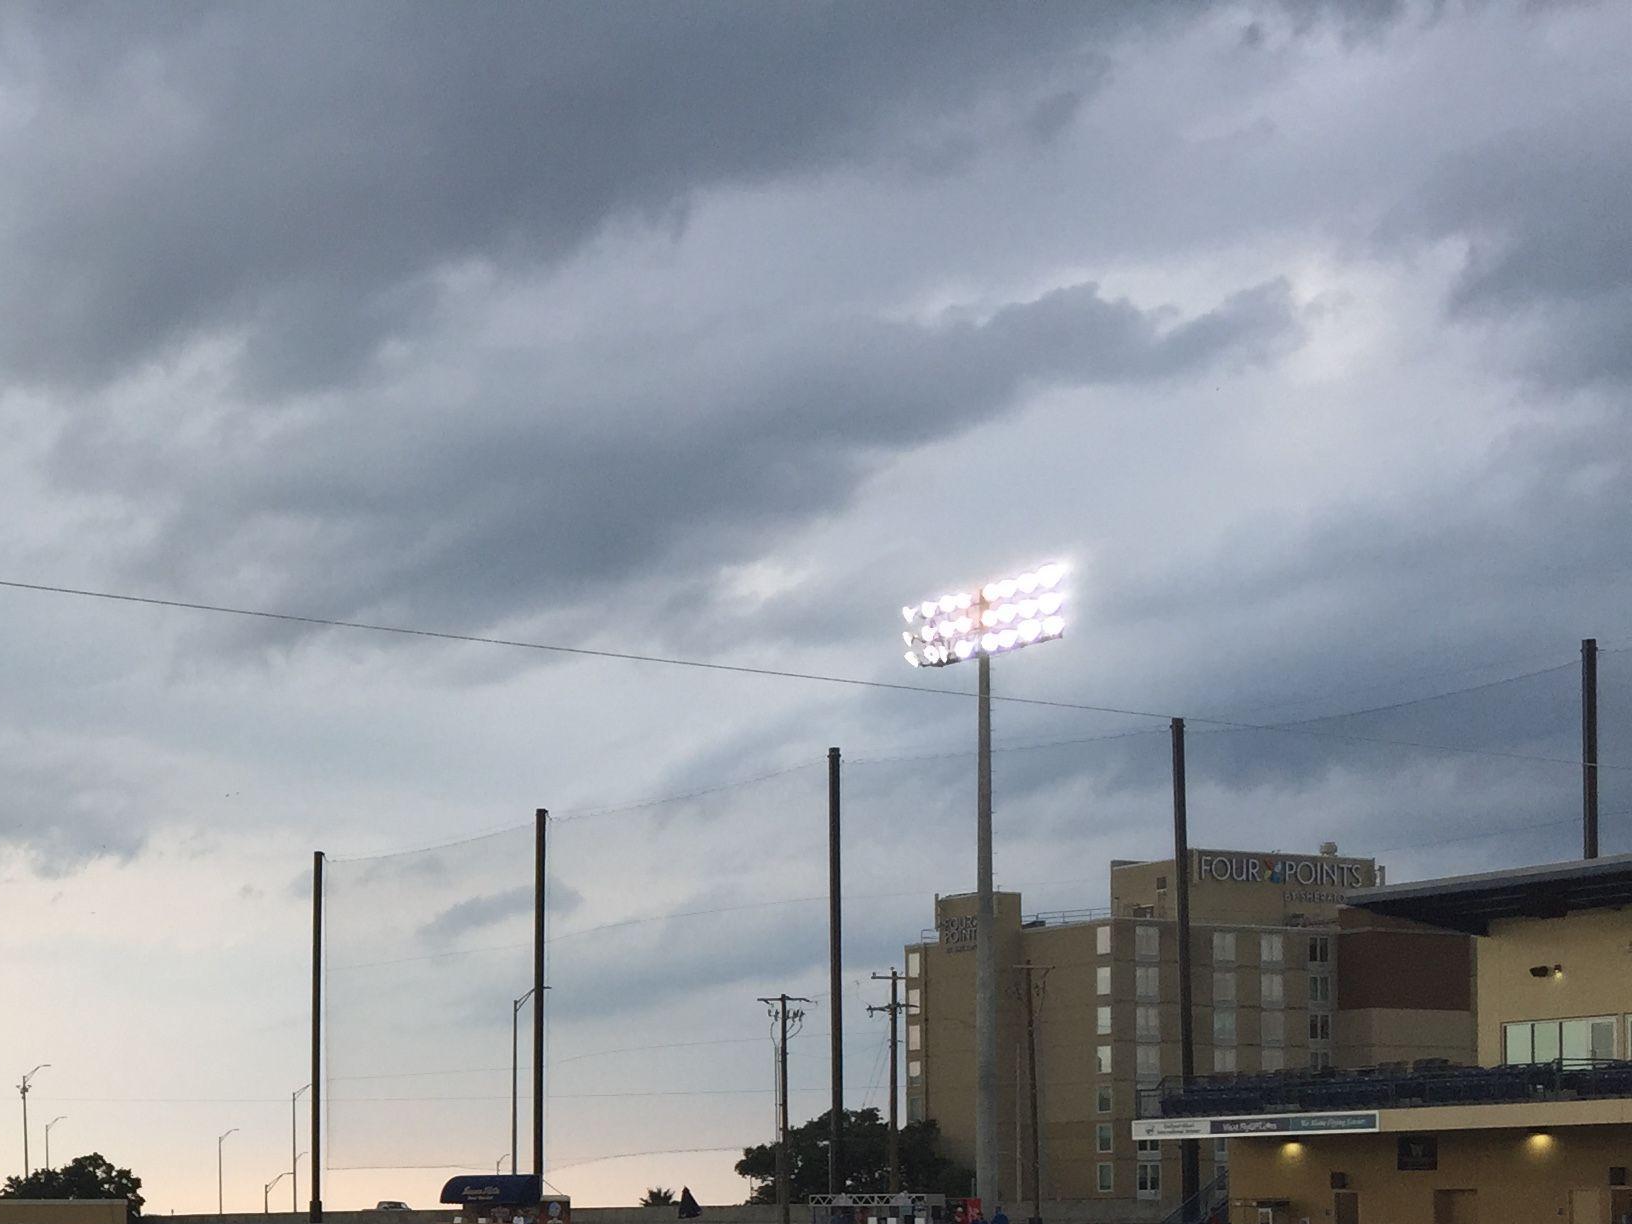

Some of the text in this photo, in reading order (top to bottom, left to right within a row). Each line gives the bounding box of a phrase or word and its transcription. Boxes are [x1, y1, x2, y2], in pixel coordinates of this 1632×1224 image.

[1201, 855, 1362, 888] FOUR POINTS
[1300, 892, 1345, 905] SHERATO
